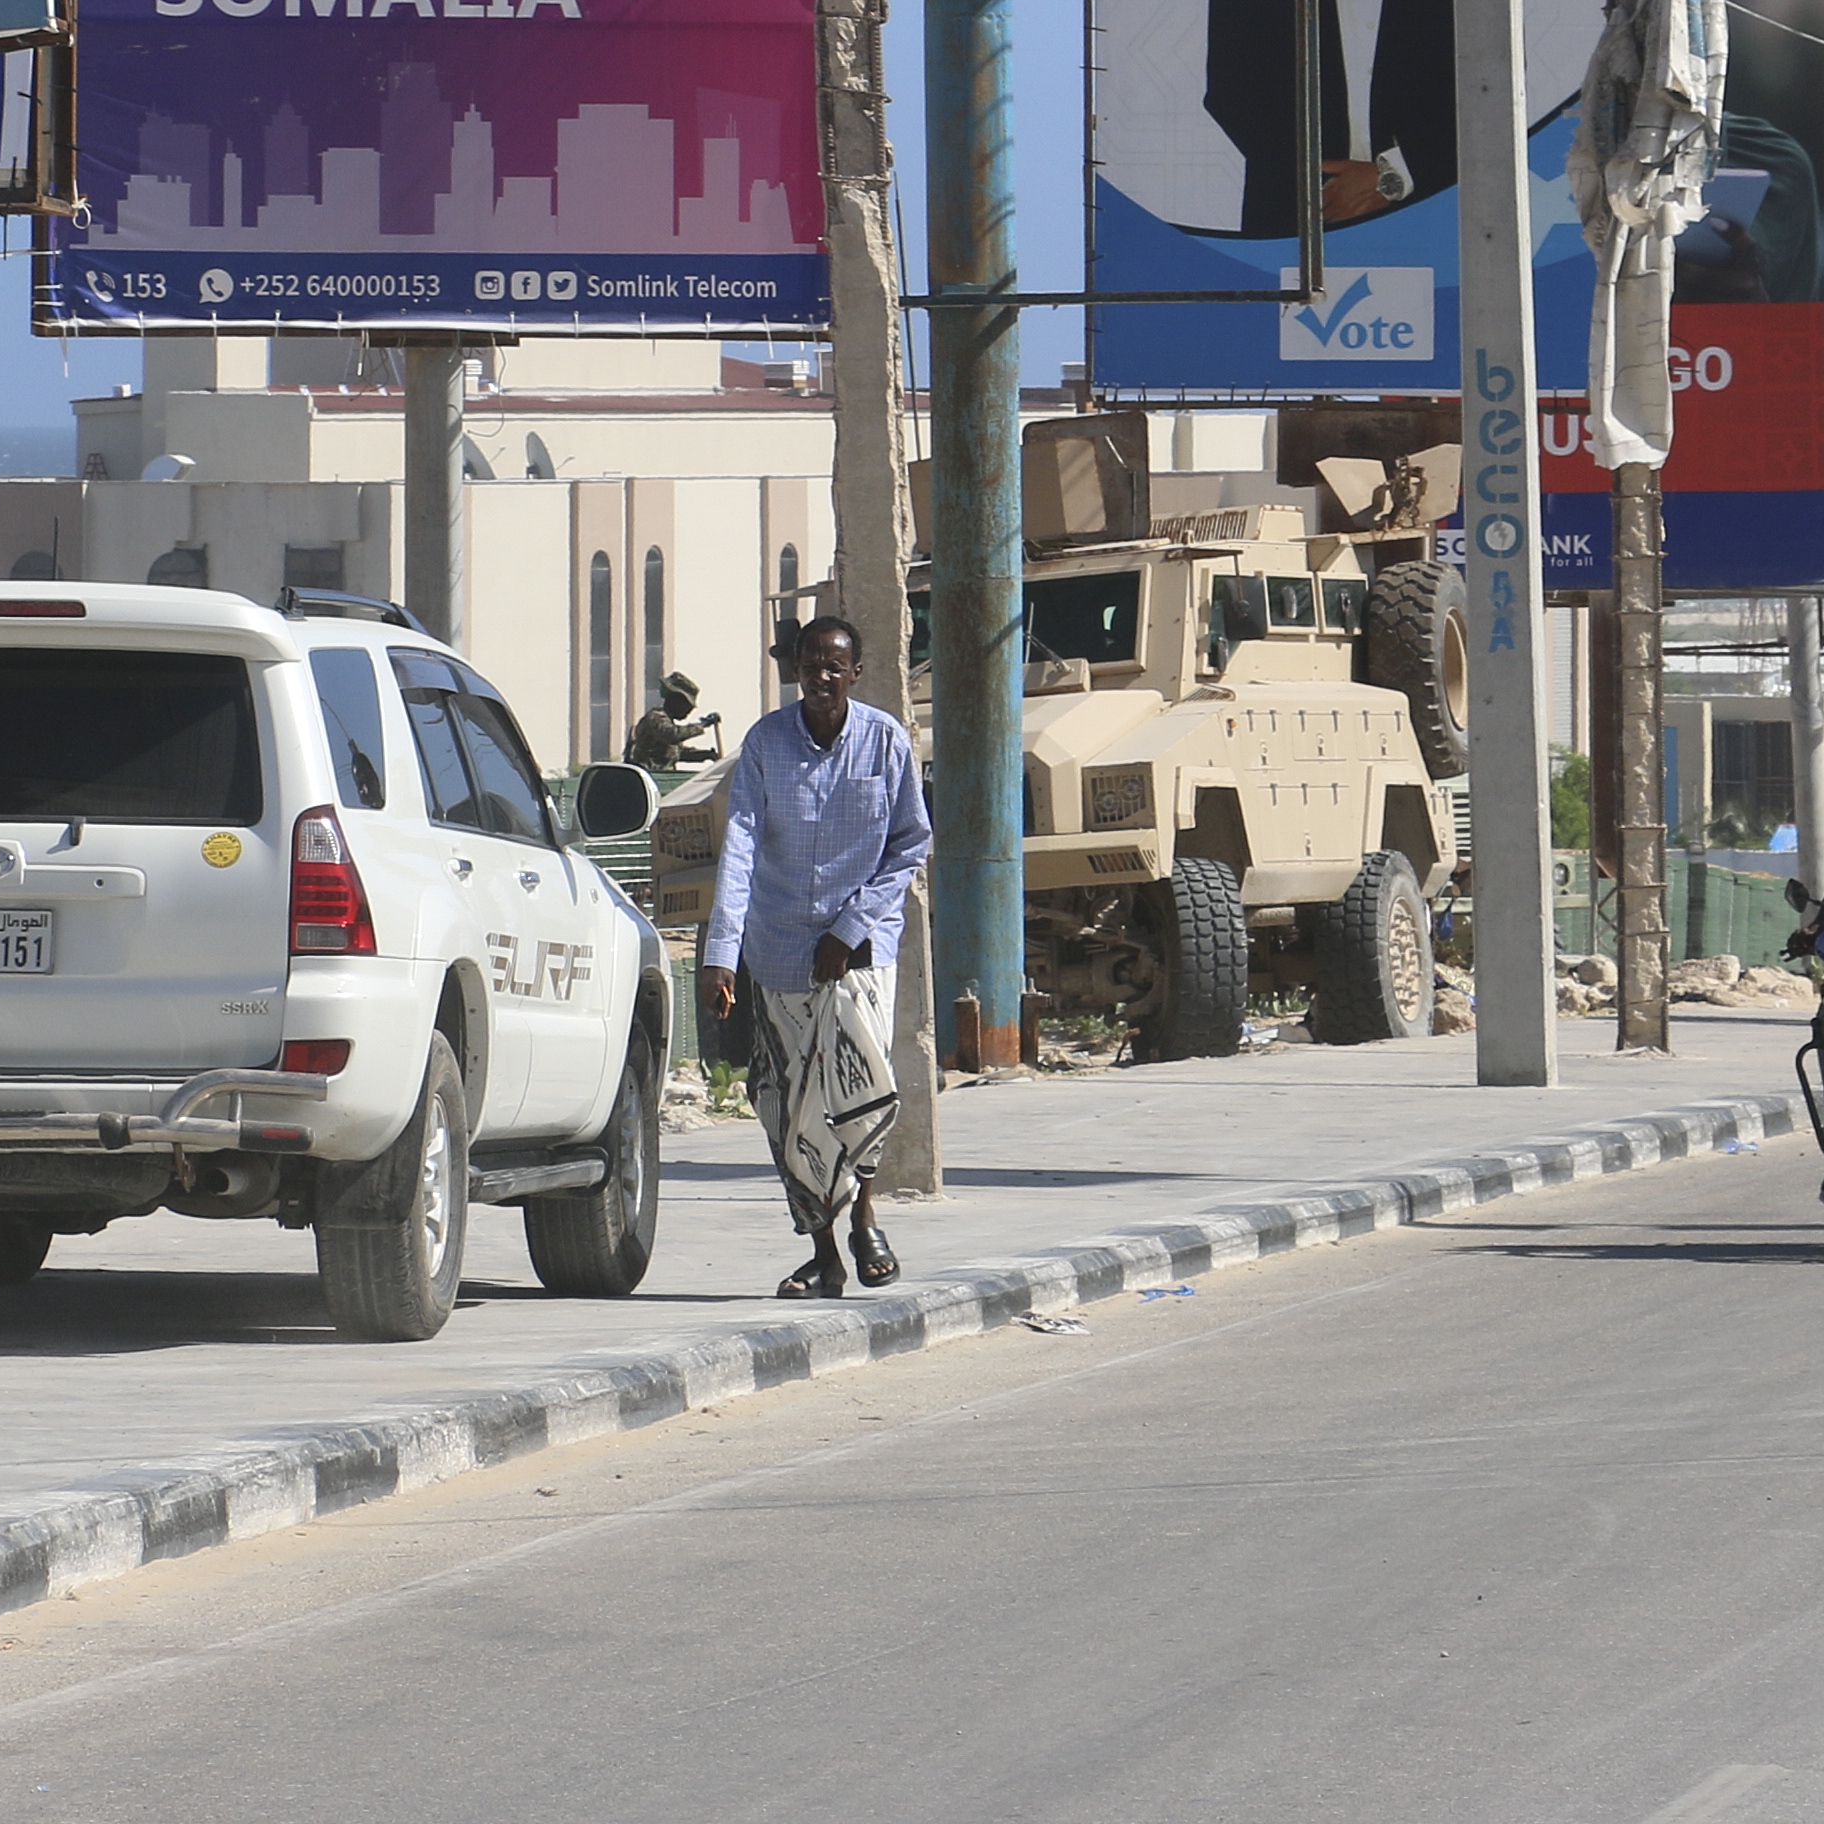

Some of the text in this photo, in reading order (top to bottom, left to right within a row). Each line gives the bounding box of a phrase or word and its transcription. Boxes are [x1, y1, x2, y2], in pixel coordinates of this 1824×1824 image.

[122, 273, 168, 299] 153
[240, 273, 442, 298] +252 640000153
[586, 273, 778, 299] Somlink Telecom
[485, 932, 594, 1001] SURF
